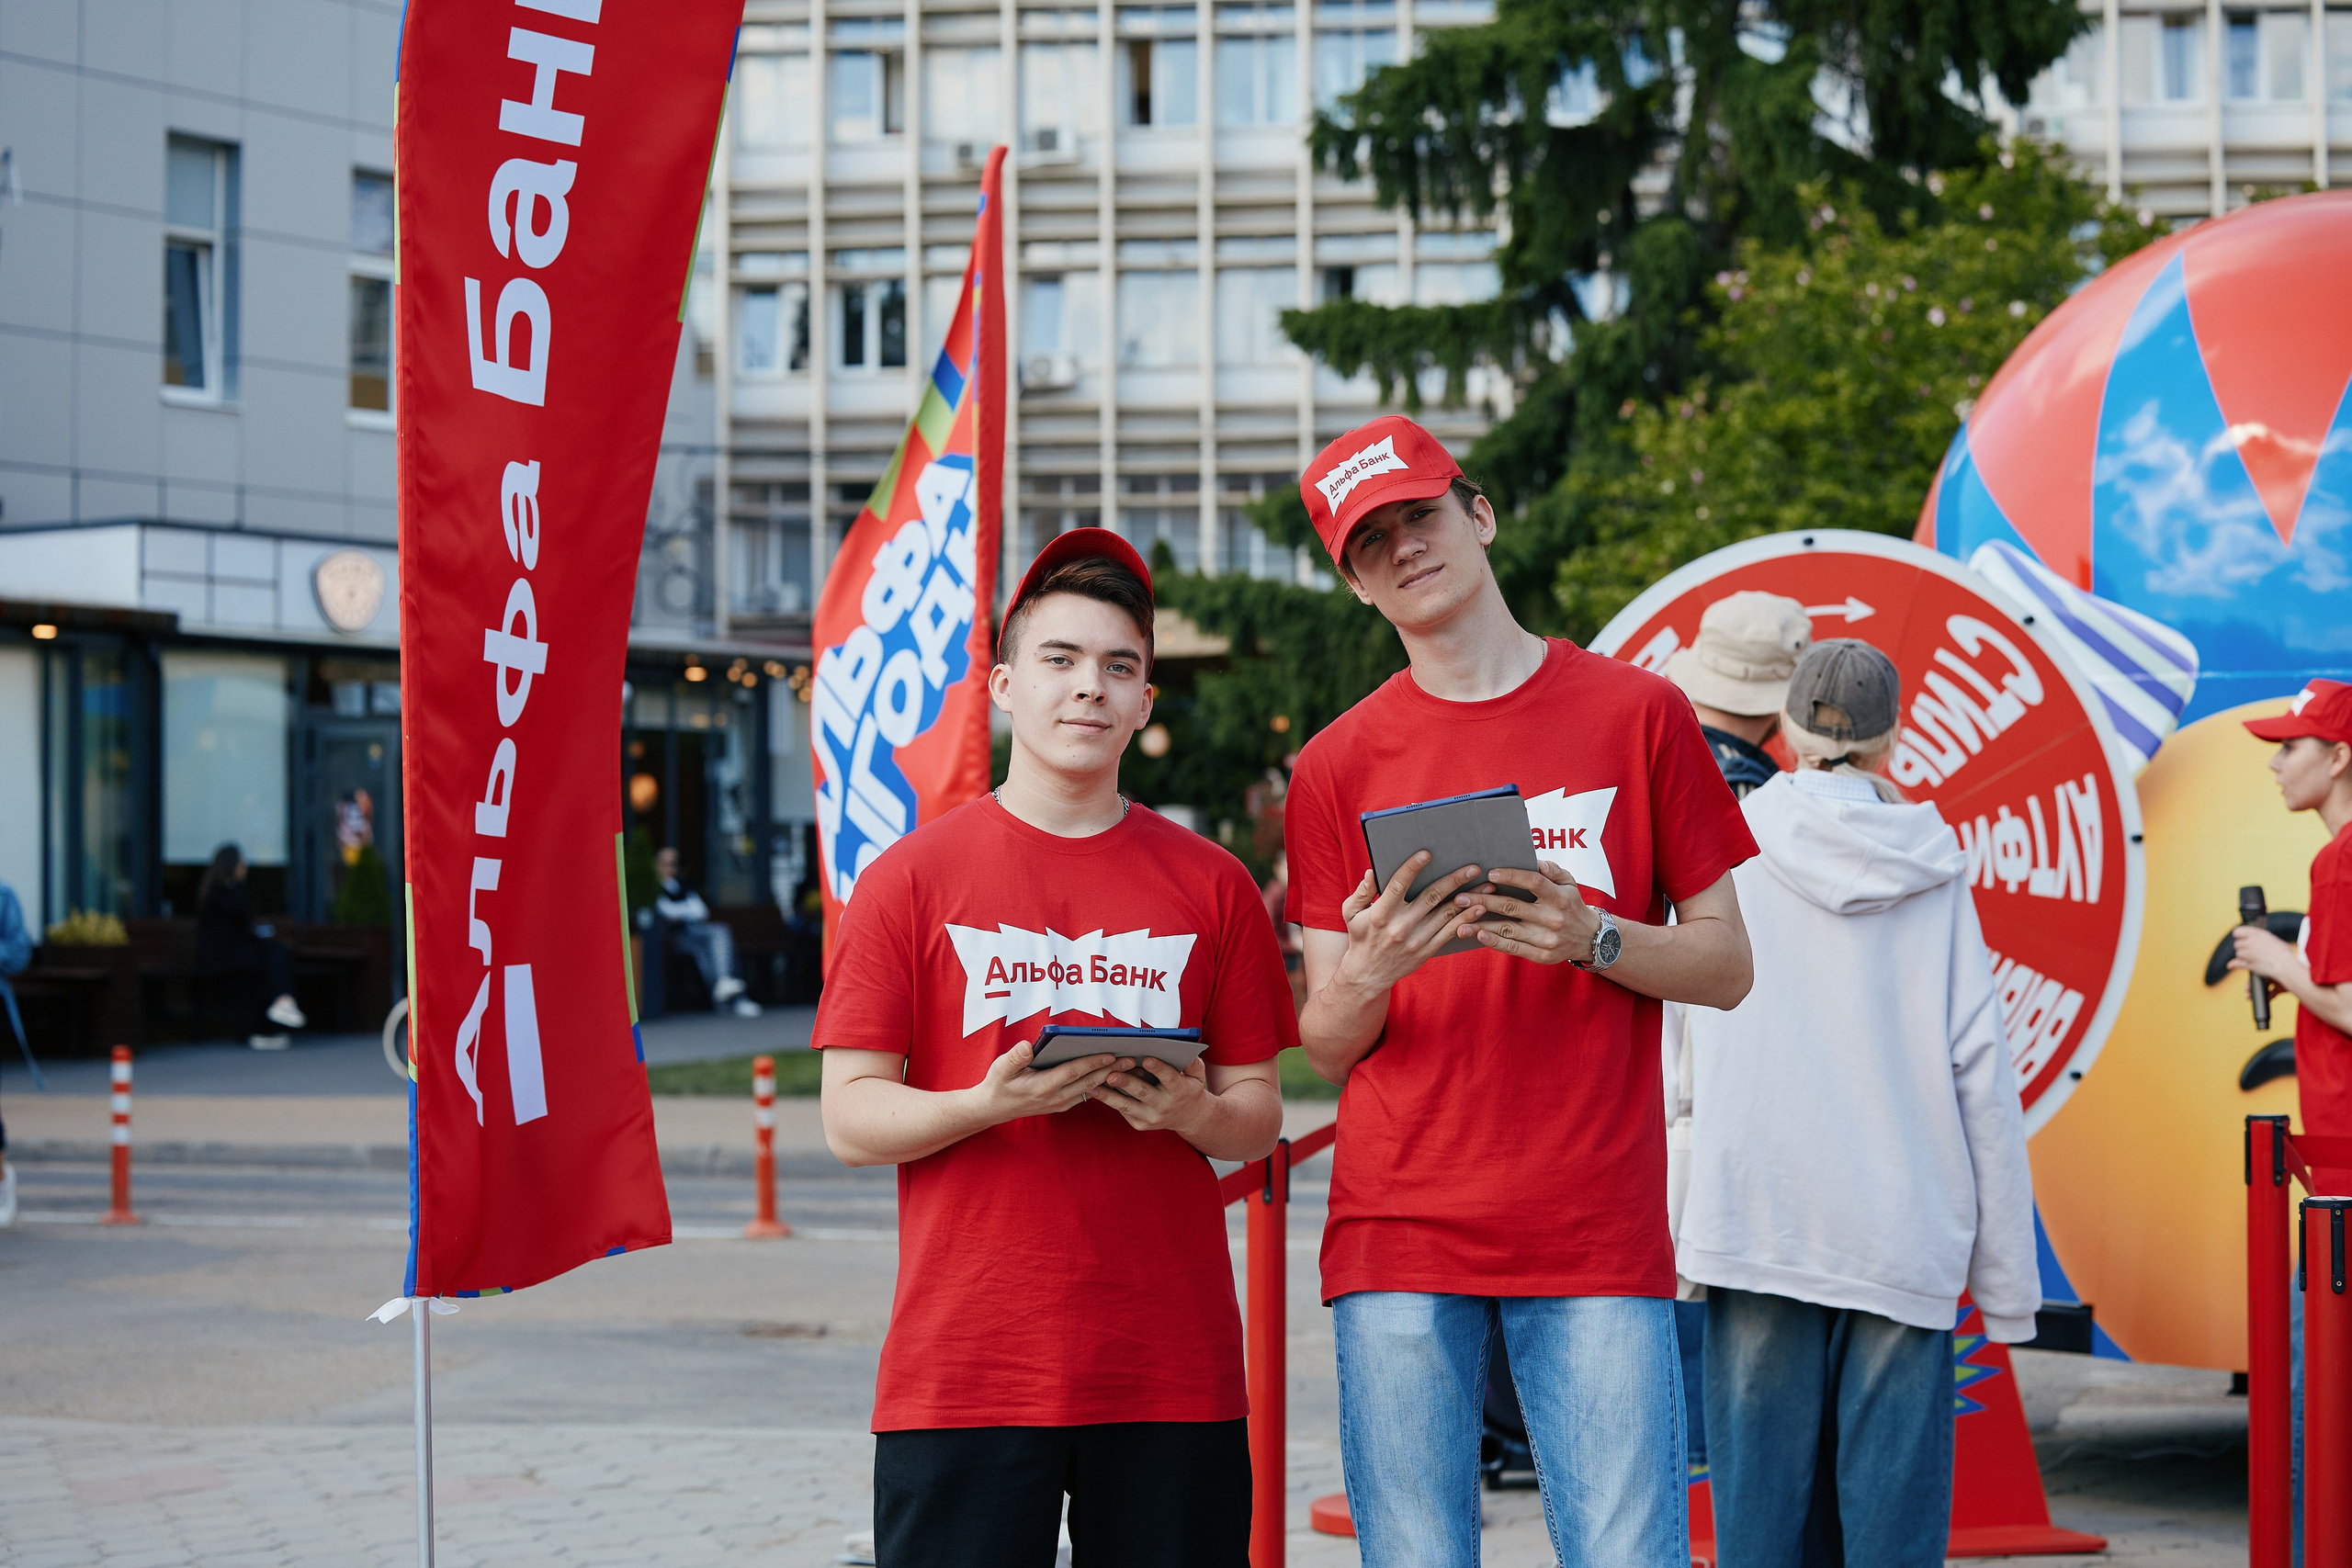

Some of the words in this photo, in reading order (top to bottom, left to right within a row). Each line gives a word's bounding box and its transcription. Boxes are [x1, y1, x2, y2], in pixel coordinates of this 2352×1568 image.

[1329, 465, 1359, 499] Альфа
[1358, 452, 1390, 469] Банк
[1889, 614, 2044, 788] СТИЛЬ
[456, 460, 549, 1127] Альфа
[1531, 827, 1588, 850] анк
[1959, 773, 2104, 904] АУТФИ
[984, 954, 1083, 998] Альфа
[1091, 955, 1168, 992] Банк
